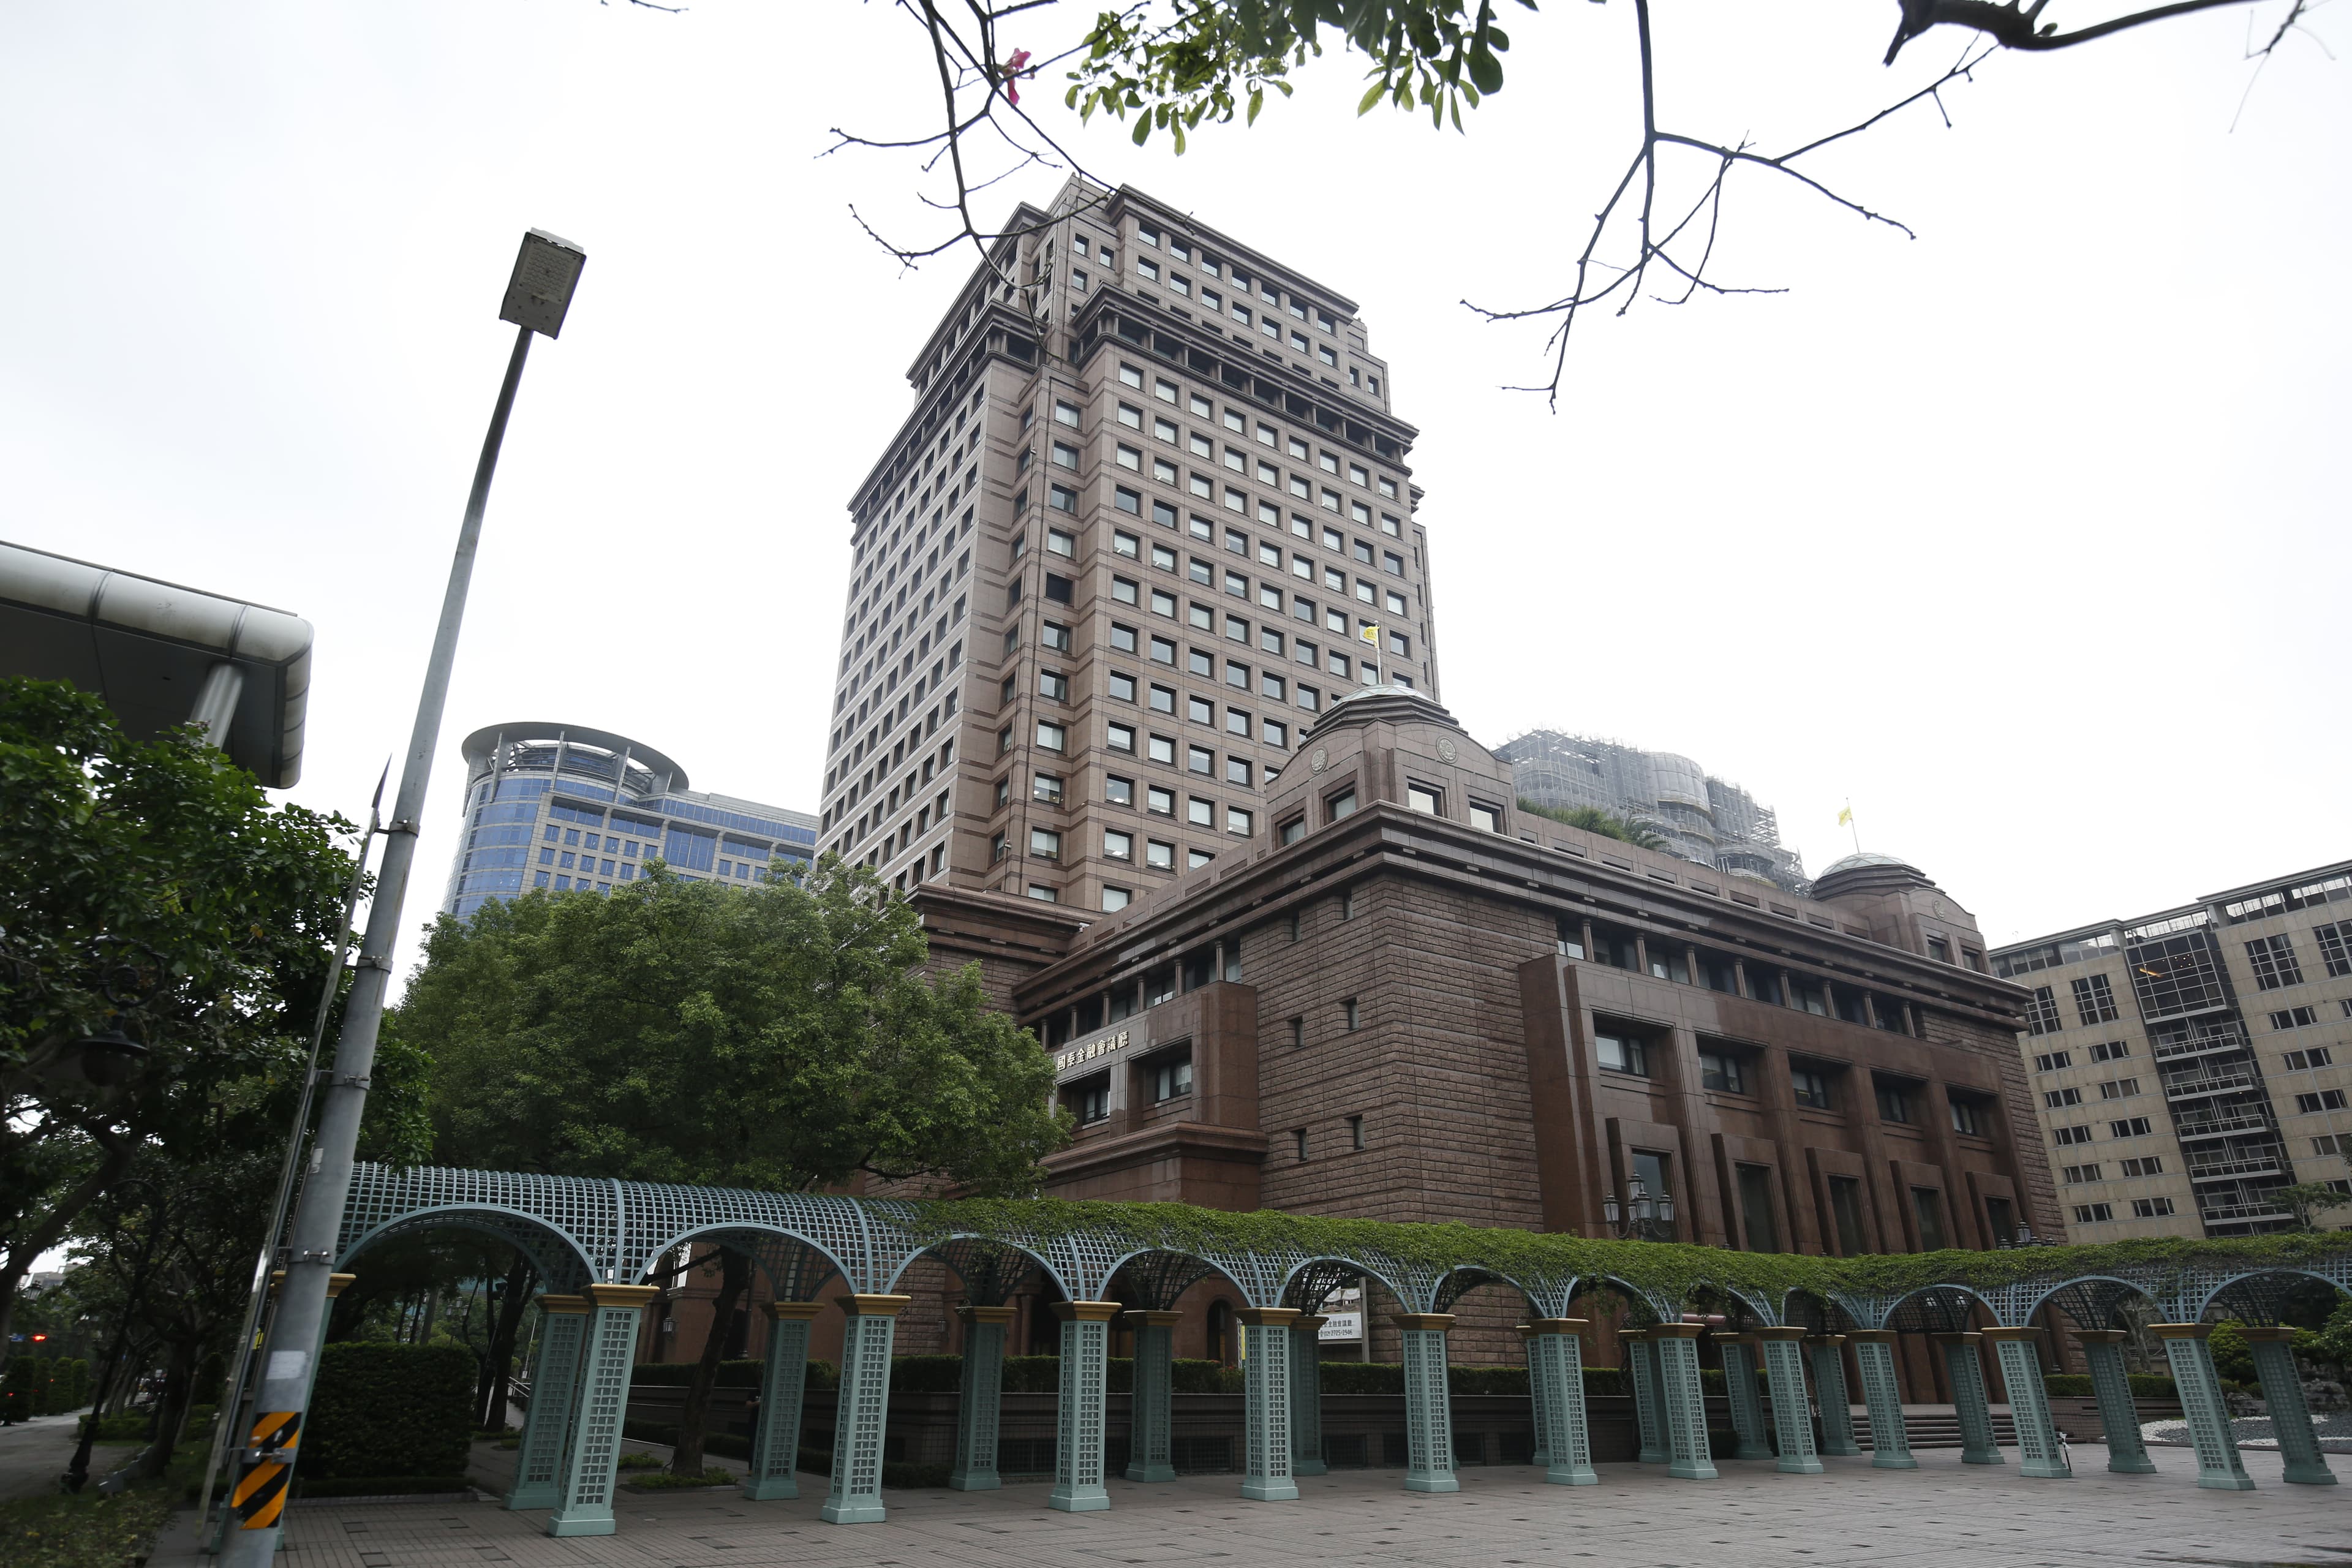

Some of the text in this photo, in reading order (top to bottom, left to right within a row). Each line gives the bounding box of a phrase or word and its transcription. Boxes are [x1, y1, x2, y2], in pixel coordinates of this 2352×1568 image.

[1057, 1031, 1128, 1071] 國泰金融會議廳
